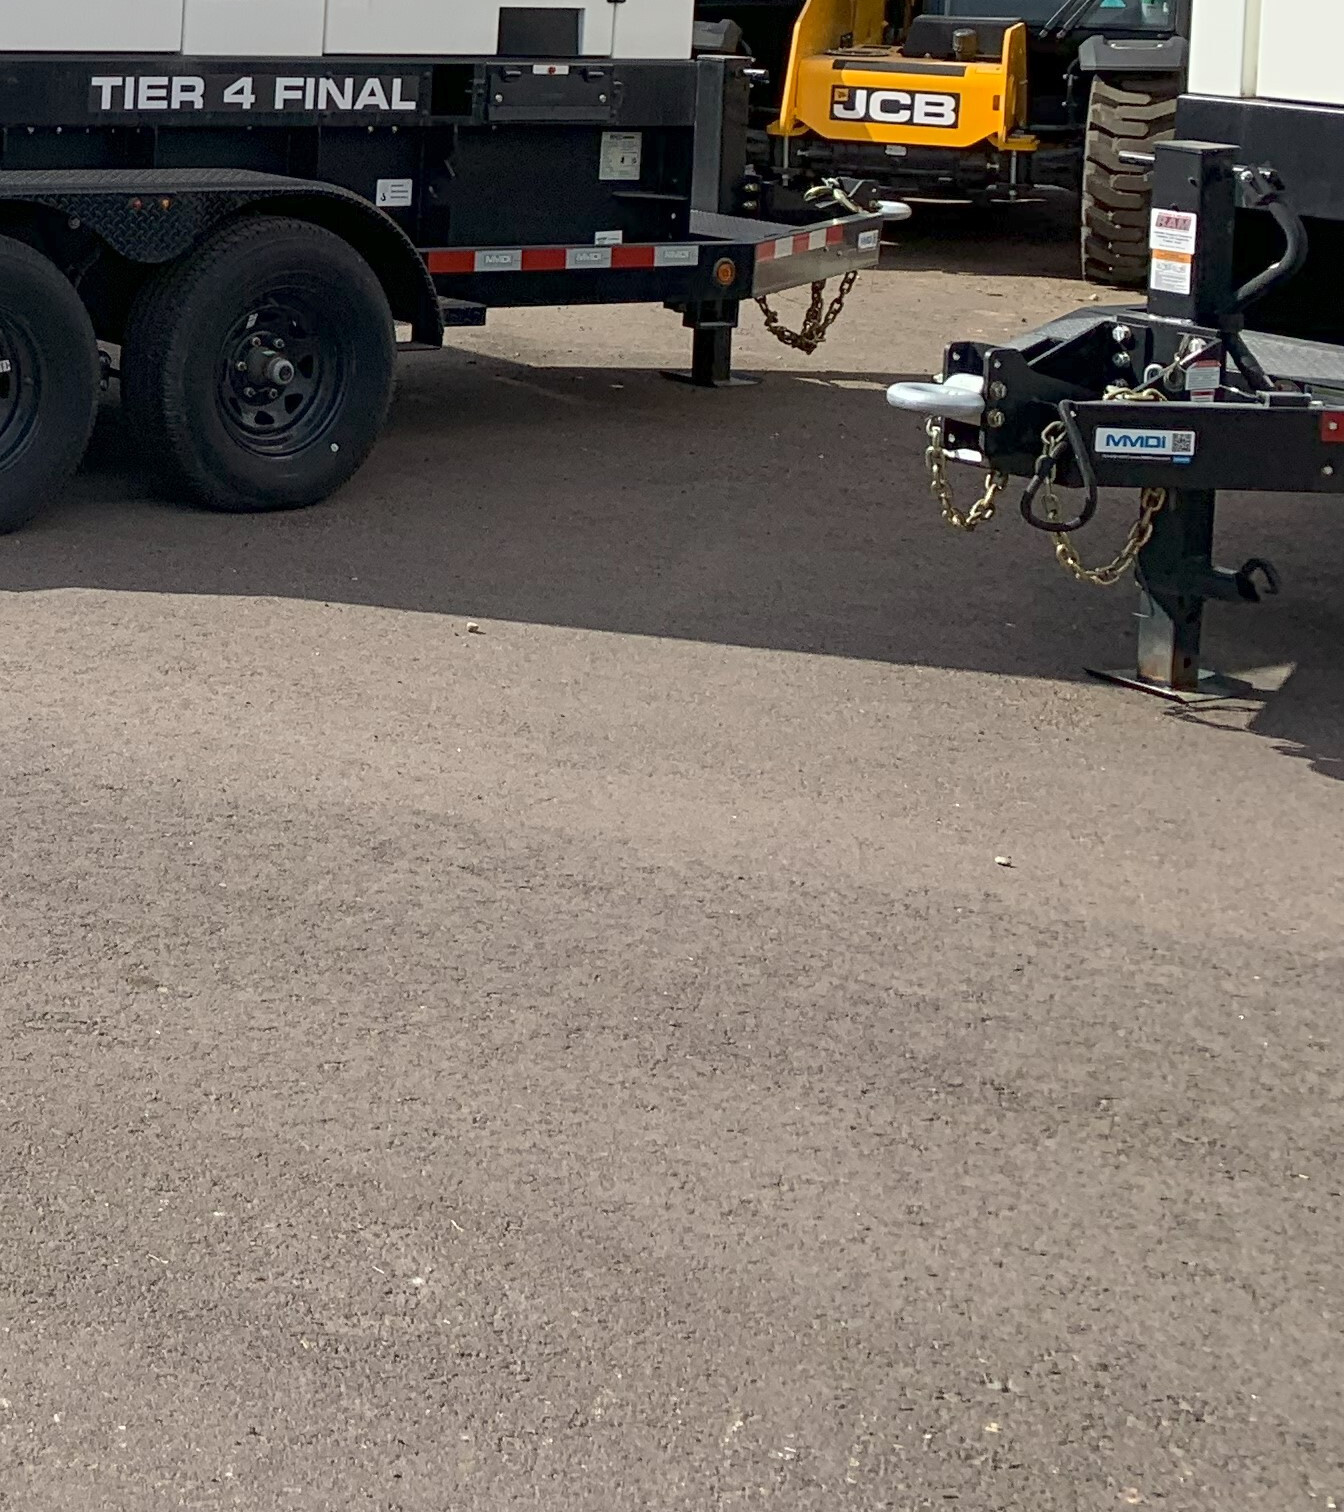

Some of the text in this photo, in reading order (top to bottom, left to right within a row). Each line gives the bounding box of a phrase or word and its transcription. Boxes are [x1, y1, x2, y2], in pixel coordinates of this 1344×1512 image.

[91, 76, 417, 109] TIER 4 FINAL
[833, 89, 956, 126] JCB
[1106, 434, 1166, 449] MMDI
